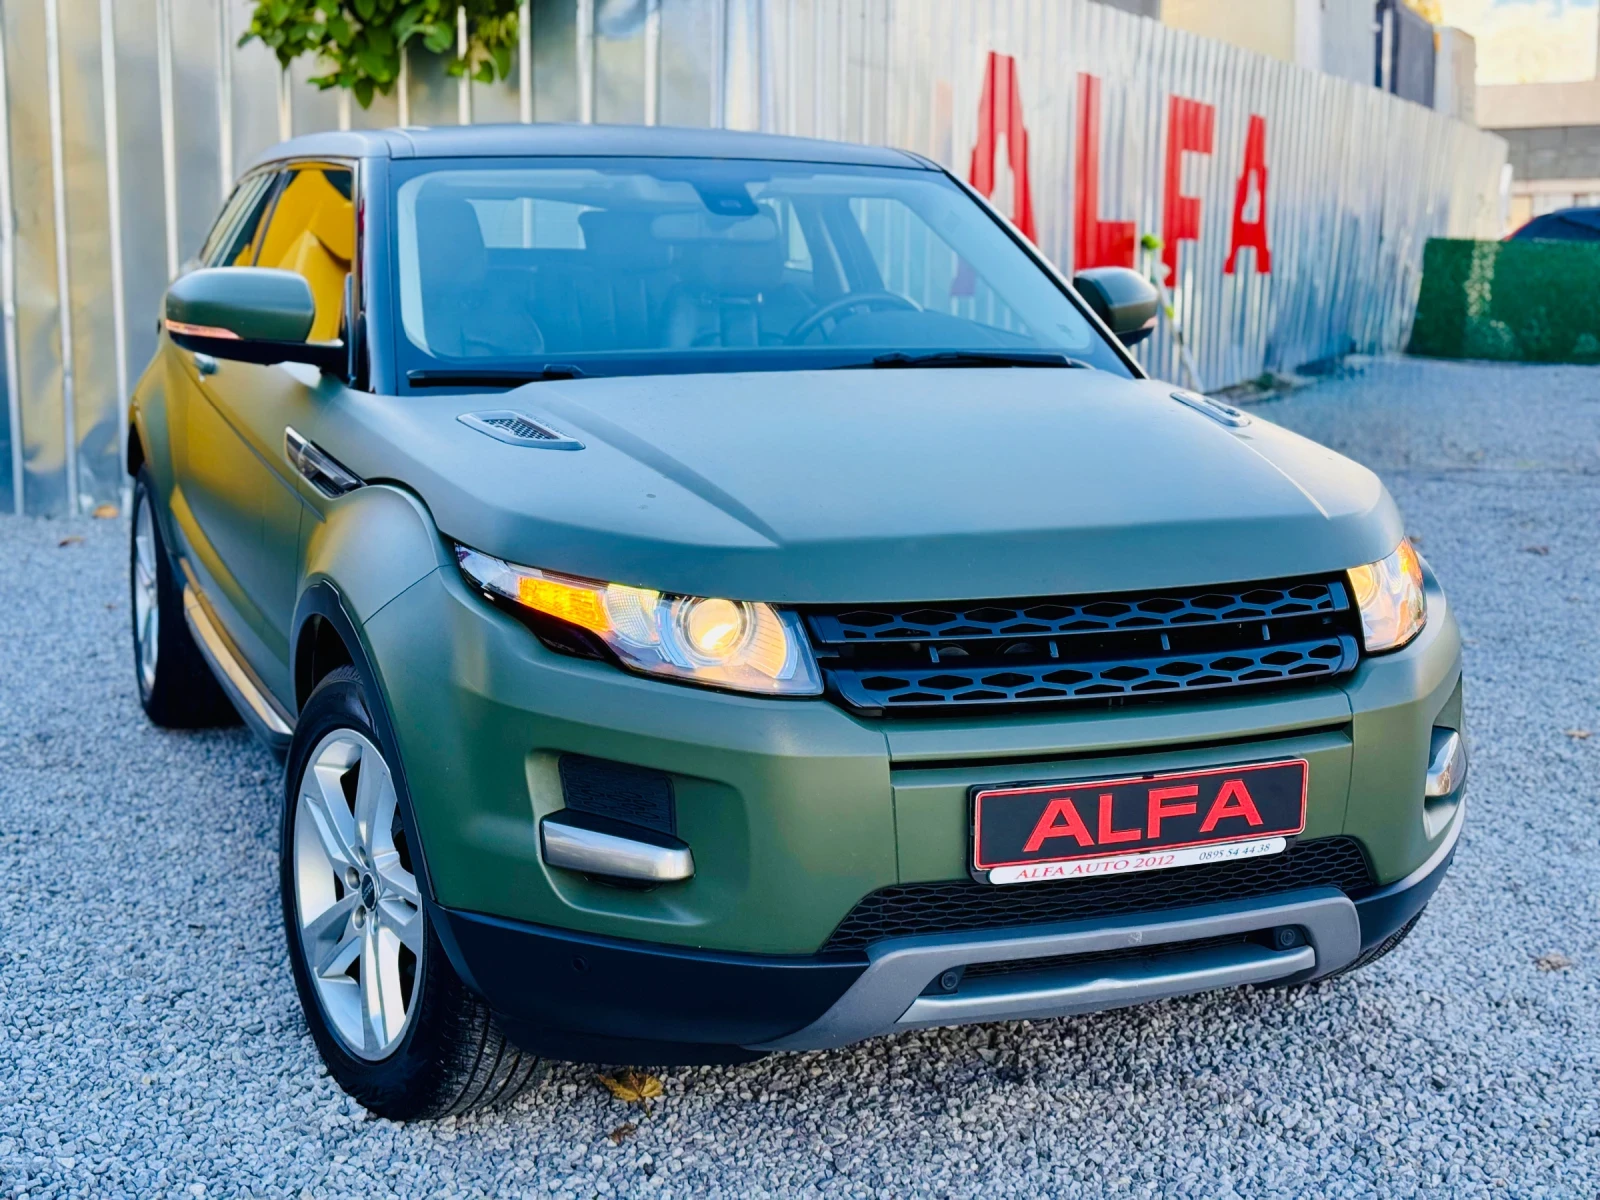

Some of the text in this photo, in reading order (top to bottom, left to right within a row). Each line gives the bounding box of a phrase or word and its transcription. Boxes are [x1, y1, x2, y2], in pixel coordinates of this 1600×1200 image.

[951, 50, 1272, 296] ALFA
[1022, 779, 1263, 852] ALFA
[1015, 854, 1175, 880] ALFA AUTO 2012
[1198, 843, 1271, 861] 0895 54 44 38
